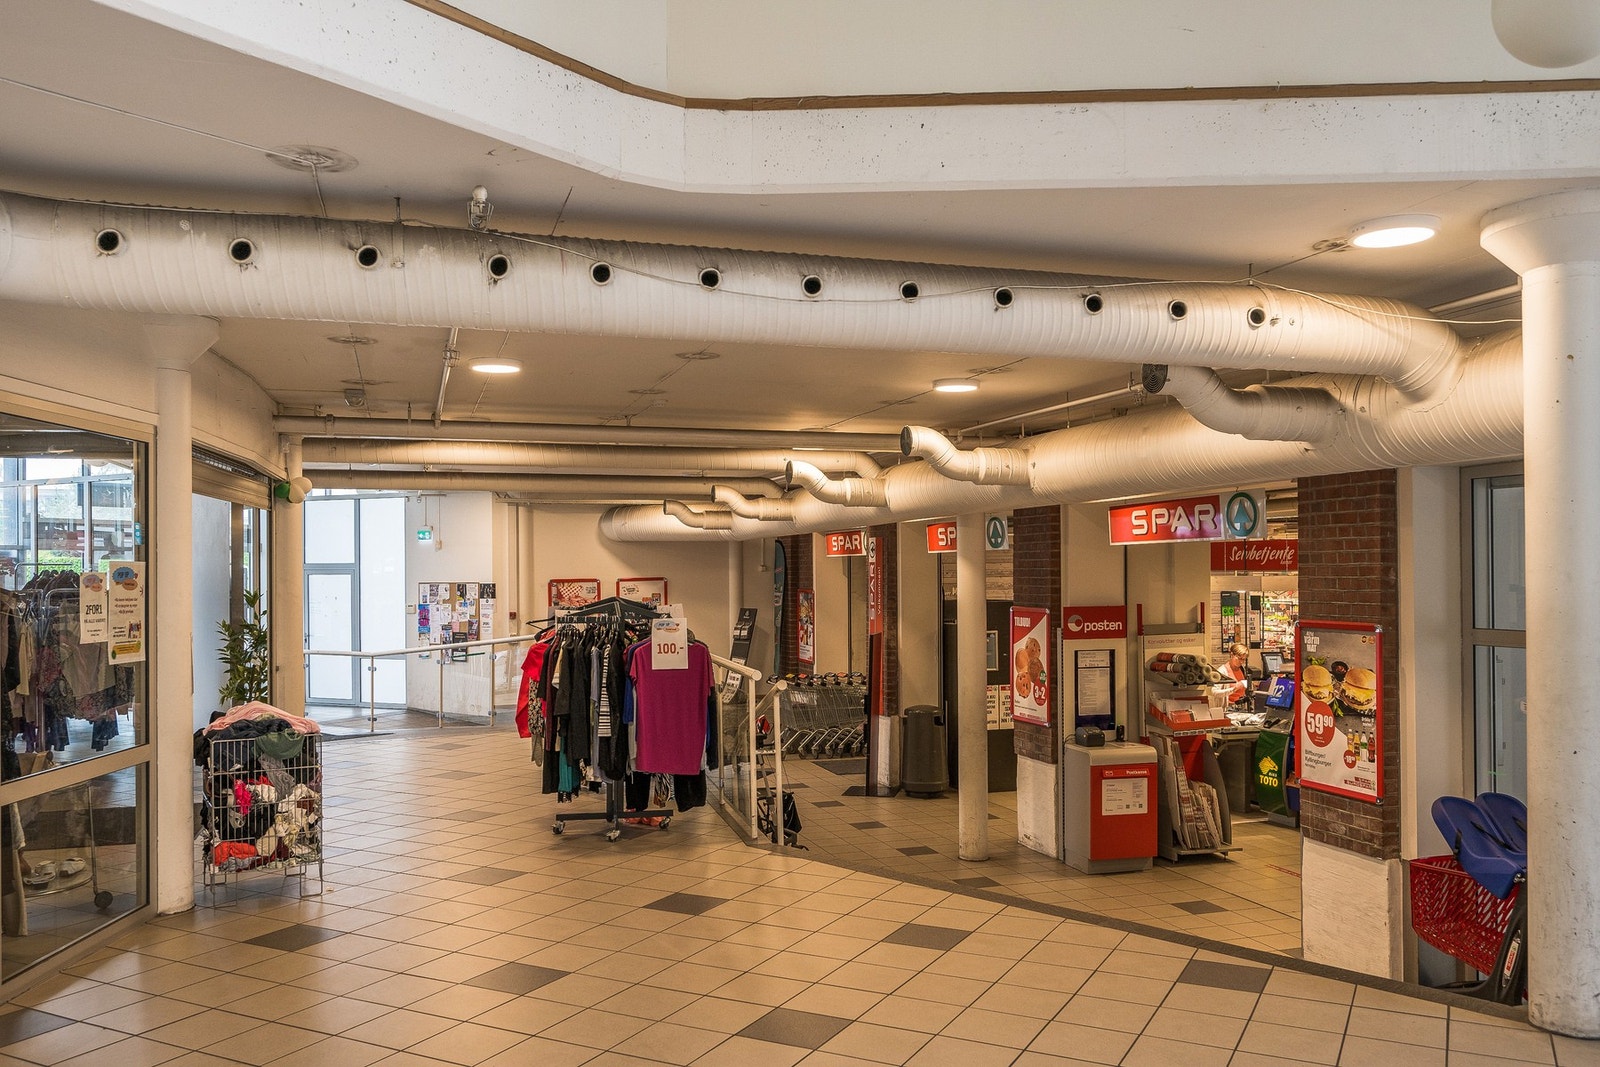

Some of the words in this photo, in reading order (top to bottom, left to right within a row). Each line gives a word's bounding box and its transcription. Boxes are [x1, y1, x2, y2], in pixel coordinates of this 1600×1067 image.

[1131, 504, 1217, 536] SPAR
[831, 534, 861, 551] SPAR
[1084, 619, 1123, 633] posten
[1260, 775, 1278, 787] TOTO
